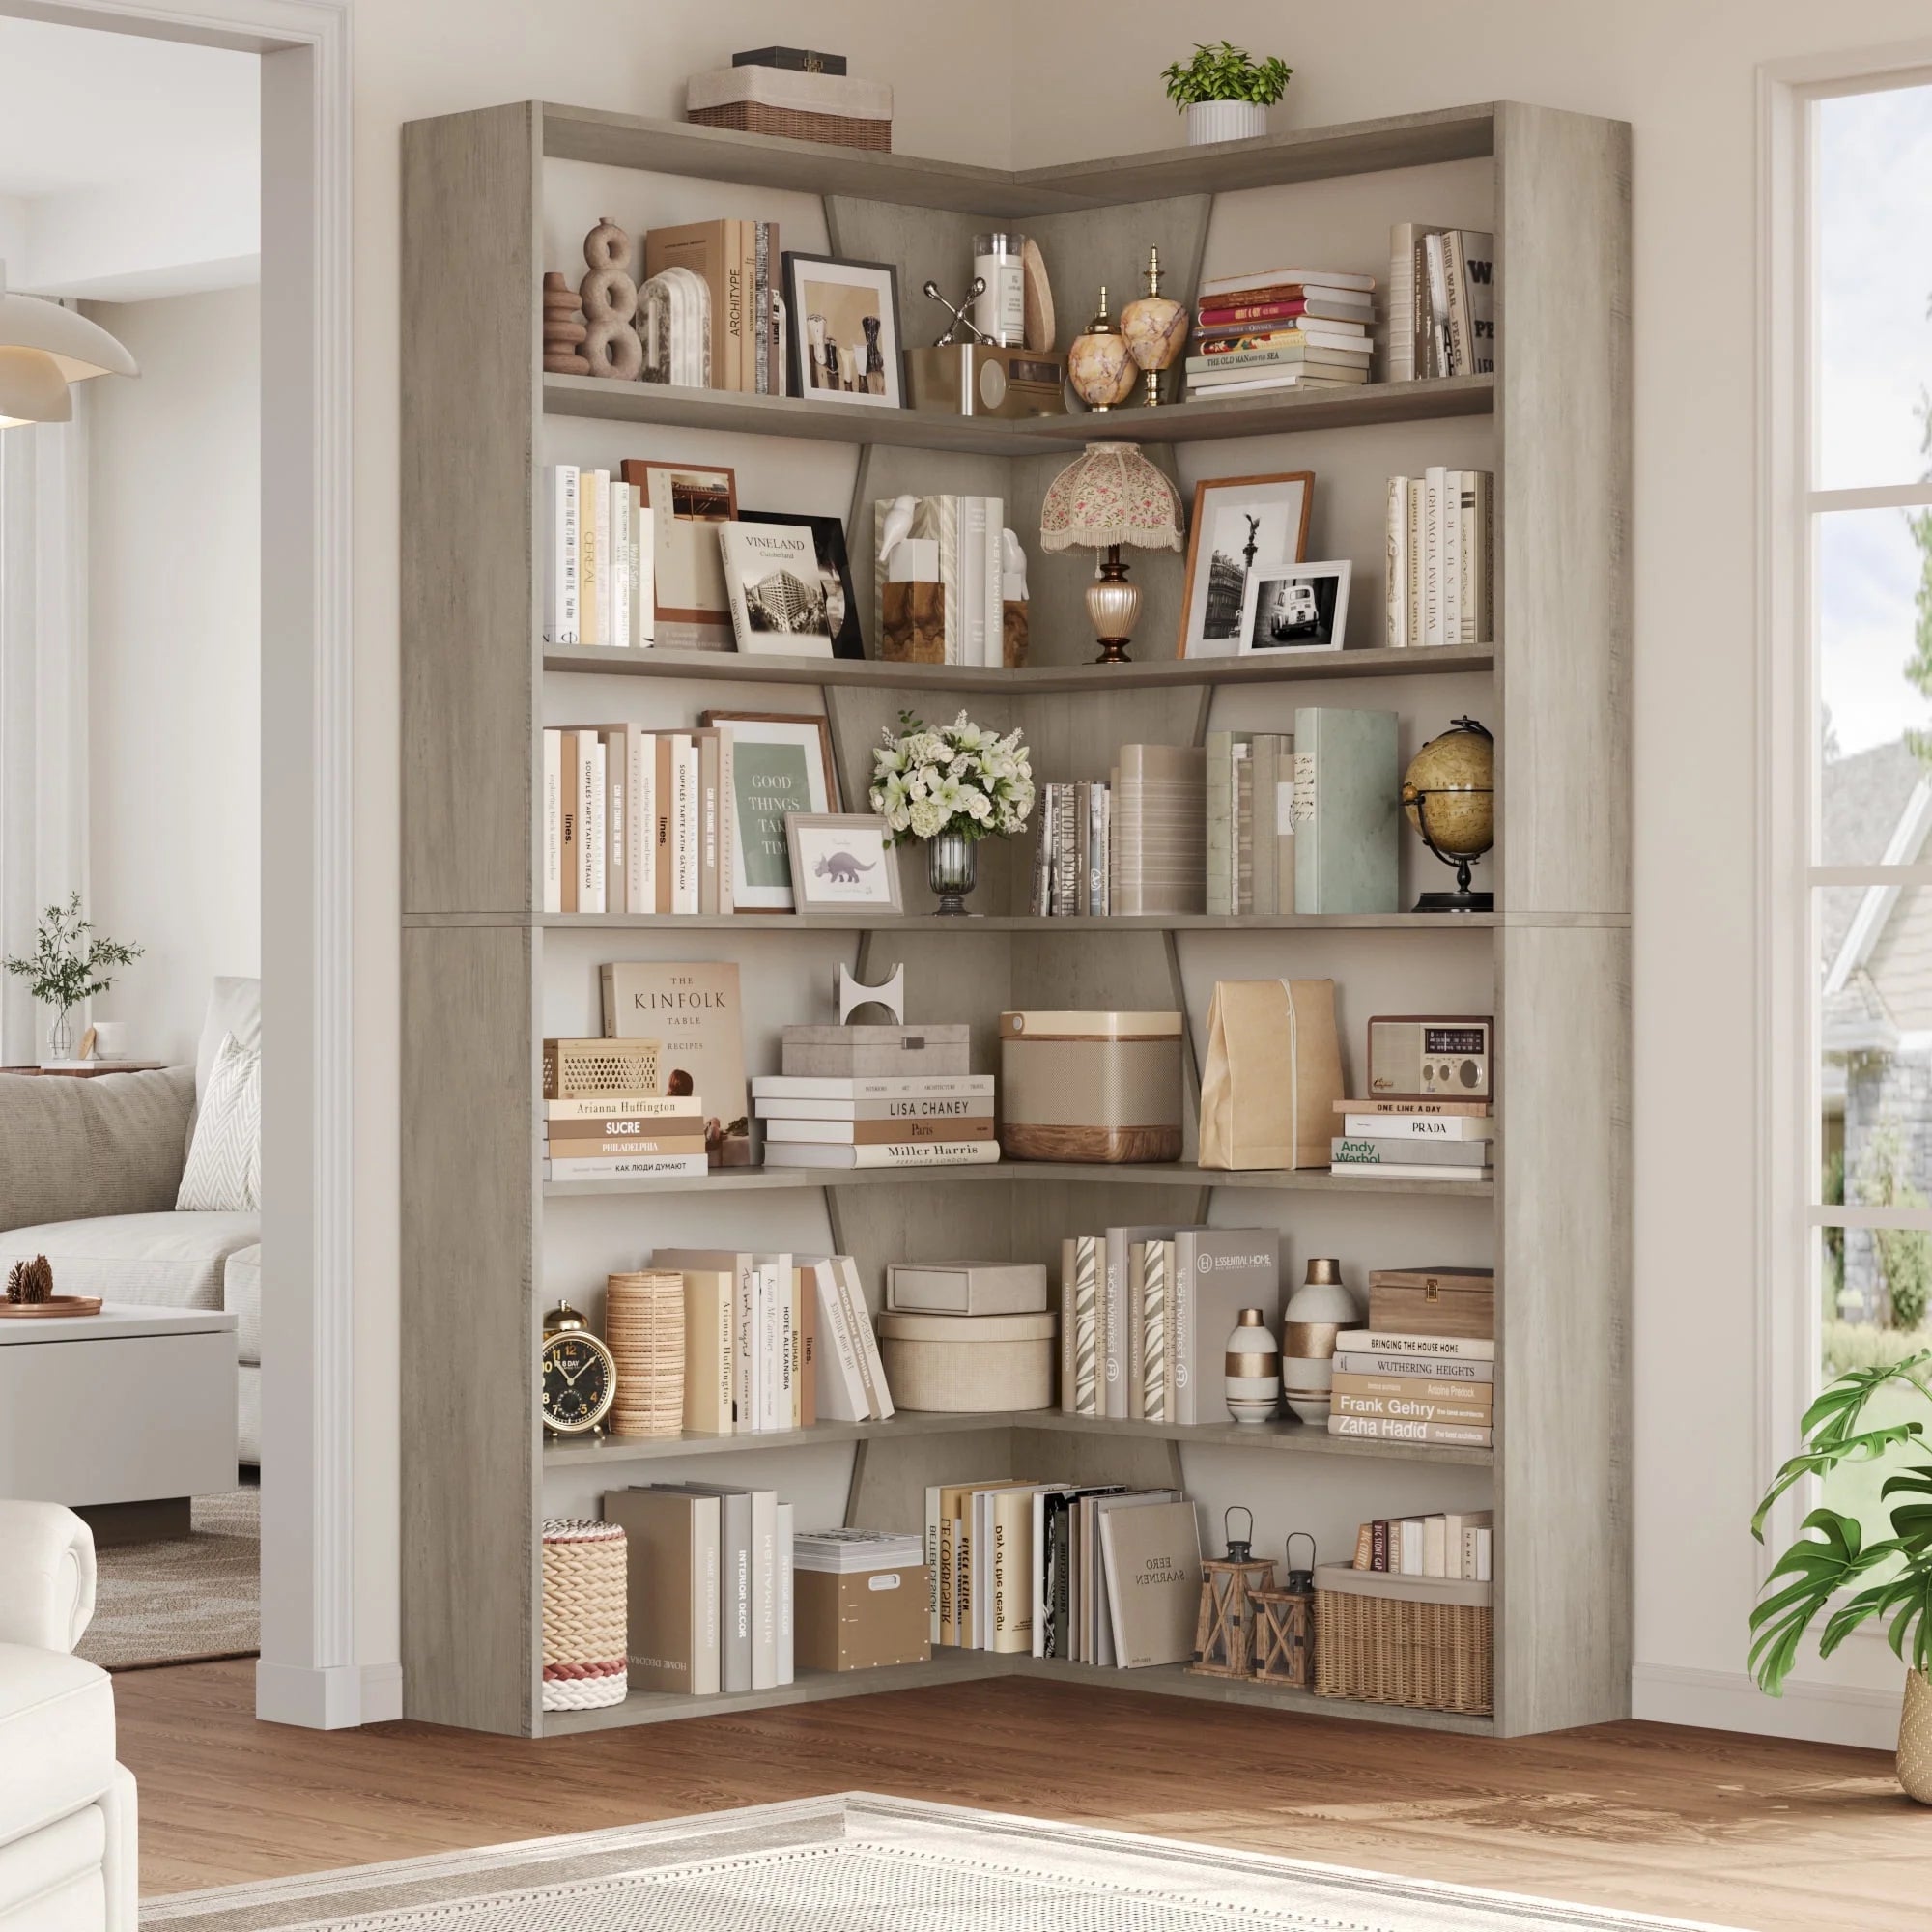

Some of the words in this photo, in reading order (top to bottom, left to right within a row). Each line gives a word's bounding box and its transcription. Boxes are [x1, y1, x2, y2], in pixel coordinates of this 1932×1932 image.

[1446, 272, 1457, 307] WAR
[730, 269, 740, 336] ARCHITYPE
[1451, 321, 1463, 366] PEACE
[1207, 357, 1219, 367] THE
[1235, 355, 1249, 364] MAN
[1266, 352, 1279, 360] SEA
[745, 535, 805, 551] VINELAND
[583, 531, 595, 591] CEREAL
[759, 551, 794, 560] Cumberland
[992, 535, 1001, 632] MINIMALISM
[1428, 567, 1436, 630] WILLIAM
[730, 597, 743, 641] VINELAND
[752, 775, 792, 789] GOOD
[748, 796, 800, 811] THINGS
[1061, 784, 1075, 840] HOLMES
[564, 814, 574, 845] lines.
[659, 816, 668, 847] lines.
[757, 818, 785, 833] TAK
[761, 840, 788, 855] TIM
[670, 977, 694, 985] THE
[634, 991, 726, 1009] KINFOLK
[577, 1103, 617, 1114] Arianna
[621, 1101, 676, 1114] Huffington
[890, 1102, 916, 1116] LISA
[922, 1101, 969, 1115] CHANEY
[605, 1121, 640, 1135] SUCRE
[911, 1122, 934, 1136] Paris
[1412, 1122, 1447, 1134] PRADA
[602, 1142, 658, 1152] PHILADELPHIA
[888, 1146, 930, 1157] Miller
[933, 1144, 978, 1155] Harris
[1341, 1141, 1376, 1155] Andy
[1335, 1152, 1380, 1163] Warhol
[631, 1163, 654, 1173] ЛЮДИ
[655, 1162, 687, 1172] ДУМАЮТ
[1214, 1255, 1249, 1267] ESSENTIAL
[1249, 1254, 1271, 1264] HOME
[1176, 1267, 1184, 1300] HOME
[723, 1301, 731, 1342] Arianna
[1176, 1301, 1184, 1359] ESSENTIAL
[564, 1345, 577, 1356] 12
[1371, 1339, 1402, 1350] BRINGING
[1403, 1341, 1416, 1350] THE
[1417, 1342, 1438, 1352] HOUSE
[1439, 1343, 1459, 1353] HOME
[553, 1349, 561, 1360] 11
[721, 1347, 731, 1405] Huffington
[1378, 1360, 1432, 1374] WUTHERING
[1436, 1365, 1475, 1377] HEIGHTS
[589, 1391, 598, 1403] 4
[1428, 1384, 1449, 1396] Antoine
[1450, 1386, 1475, 1399] Predock
[552, 1405, 558, 1415] 7
[580, 1403, 587, 1414] 5
[1340, 1396, 1384, 1413] Frank
[1387, 1399, 1435, 1420] Gehry
[1339, 1416, 1378, 1435] Zaha
[1381, 1419, 1429, 1439] Hadid
[1374, 1524, 1383, 1536] BIG
[1390, 1526, 1399, 1538] BIG
[1374, 1537, 1383, 1556] STONE
[1390, 1539, 1399, 1563] CHERRY
[1374, 1557, 1383, 1570] GAP
[738, 1549, 747, 1601] INTERIOR
[764, 1534, 773, 1644] MINIMALISM
[738, 1602, 747, 1638] DECOR
[629, 1655, 662, 1668] DECORA
[663, 1660, 687, 1671] HOME
